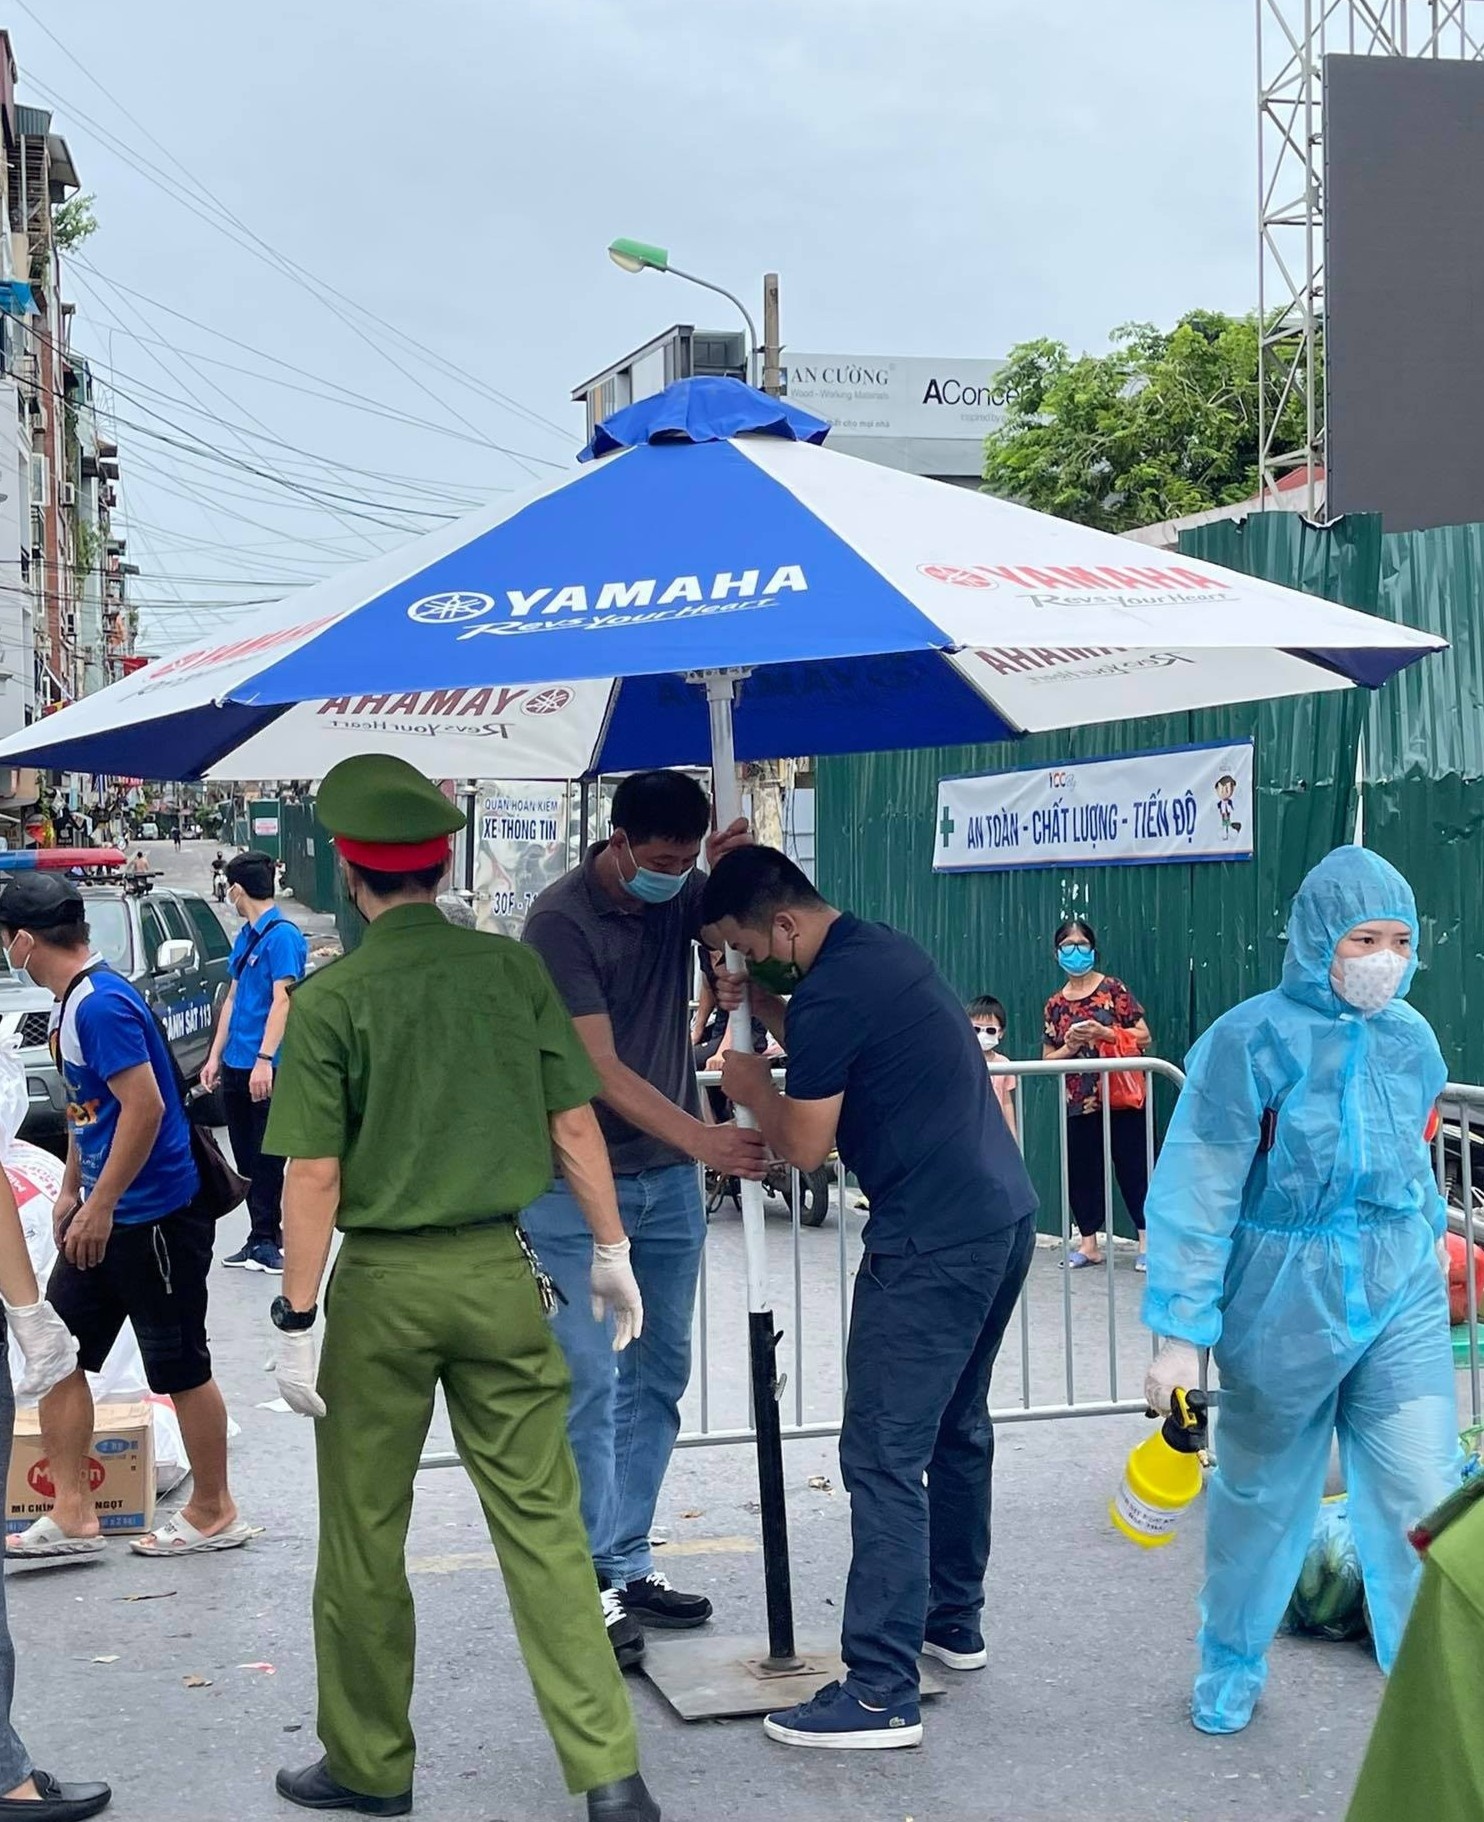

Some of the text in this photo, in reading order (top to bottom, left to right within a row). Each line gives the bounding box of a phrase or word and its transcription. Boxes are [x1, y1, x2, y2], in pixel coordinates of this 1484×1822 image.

[791, 364, 889, 385] AN CƯỜNG
[922, 379, 1021, 406] AConce
[506, 565, 808, 616] YAMAHA
[976, 566, 1234, 589] YAMAHA
[456, 618, 583, 640] Revs
[675, 599, 777, 619] Heart
[484, 818, 497, 838] XE
[540, 820, 557, 840] TIN
[968, 817, 983, 849] AN
[986, 807, 1019, 848] TOÀN
[1032, 797, 1069, 845] CHẤT
[1073, 803, 1118, 849] LƯỢNG
[1133, 788, 1170, 839] TIẾN
[1172, 790, 1197, 843] ĐỘ
